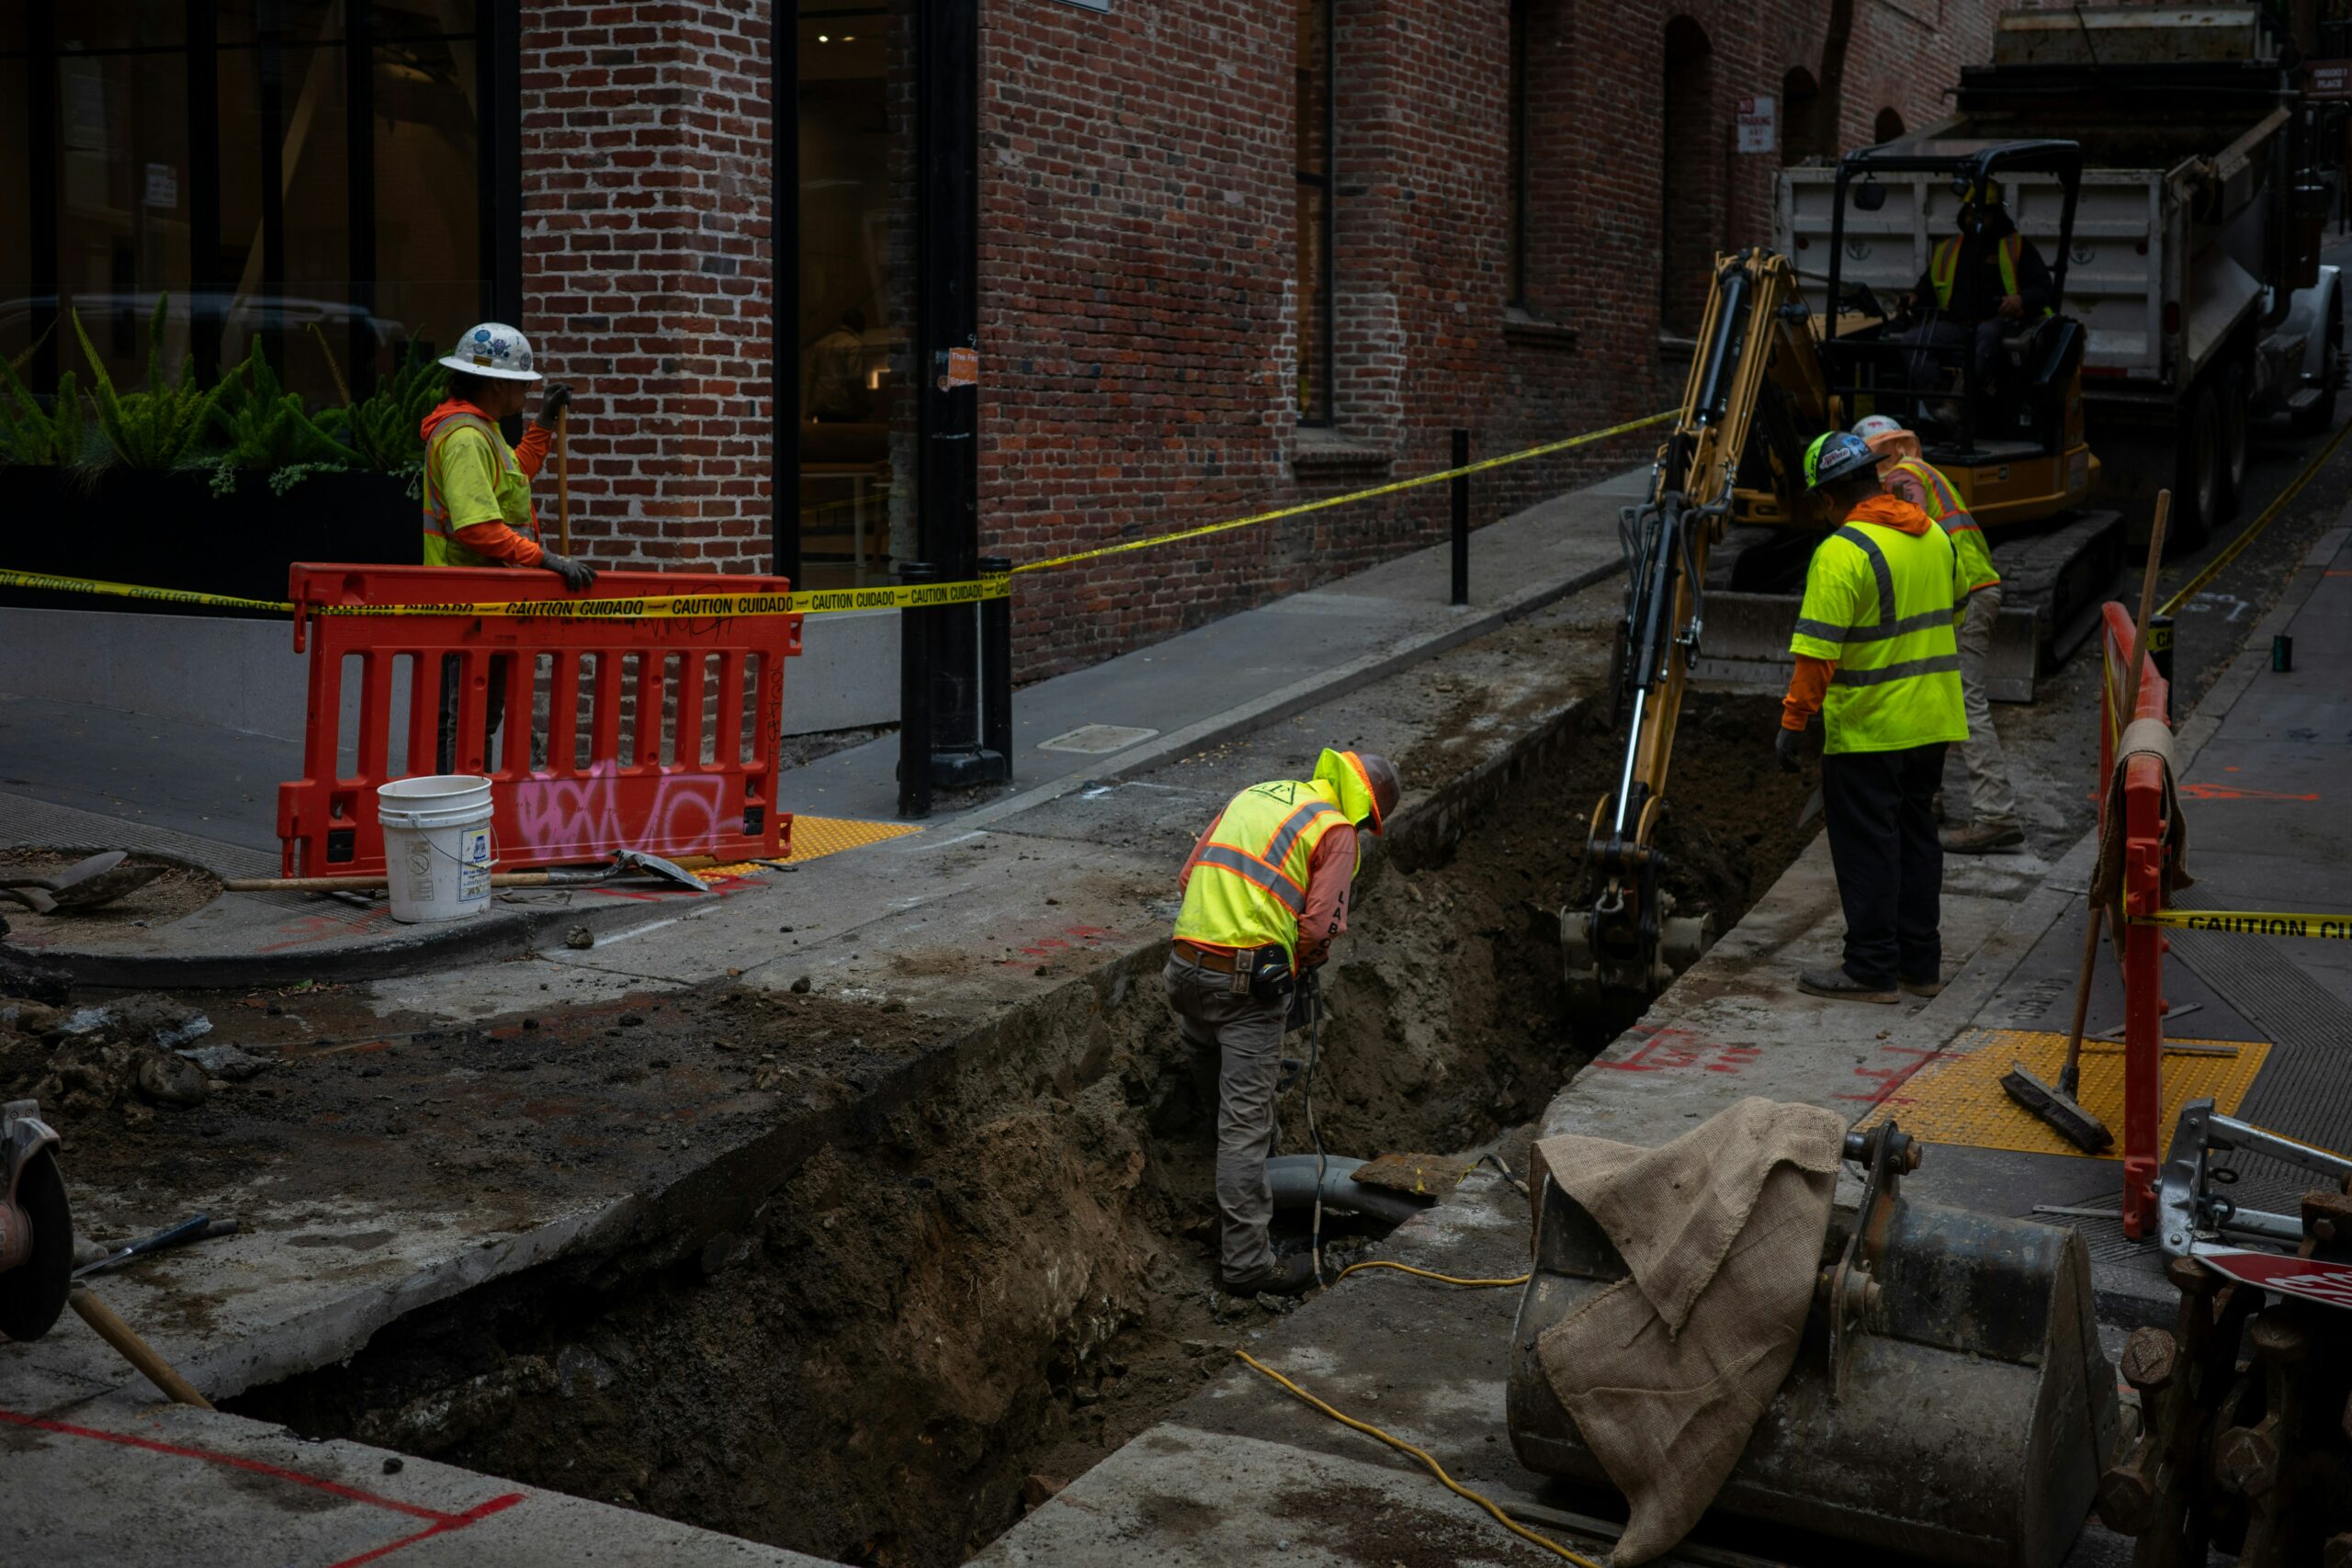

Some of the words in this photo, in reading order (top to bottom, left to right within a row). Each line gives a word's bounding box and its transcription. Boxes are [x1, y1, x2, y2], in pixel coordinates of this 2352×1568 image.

[505, 602, 573, 615] CAUTION
[579, 600, 644, 615] CUIDADO
[672, 597, 733, 615] CAUTION
[738, 596, 793, 614] CUIDADO
[811, 592, 854, 610] CAUTION
[856, 590, 895, 608] CUIDADO
[910, 587, 949, 604] CAUTION
[950, 583, 984, 602] CUIDADO
[2188, 916, 2307, 937] CAUTION
